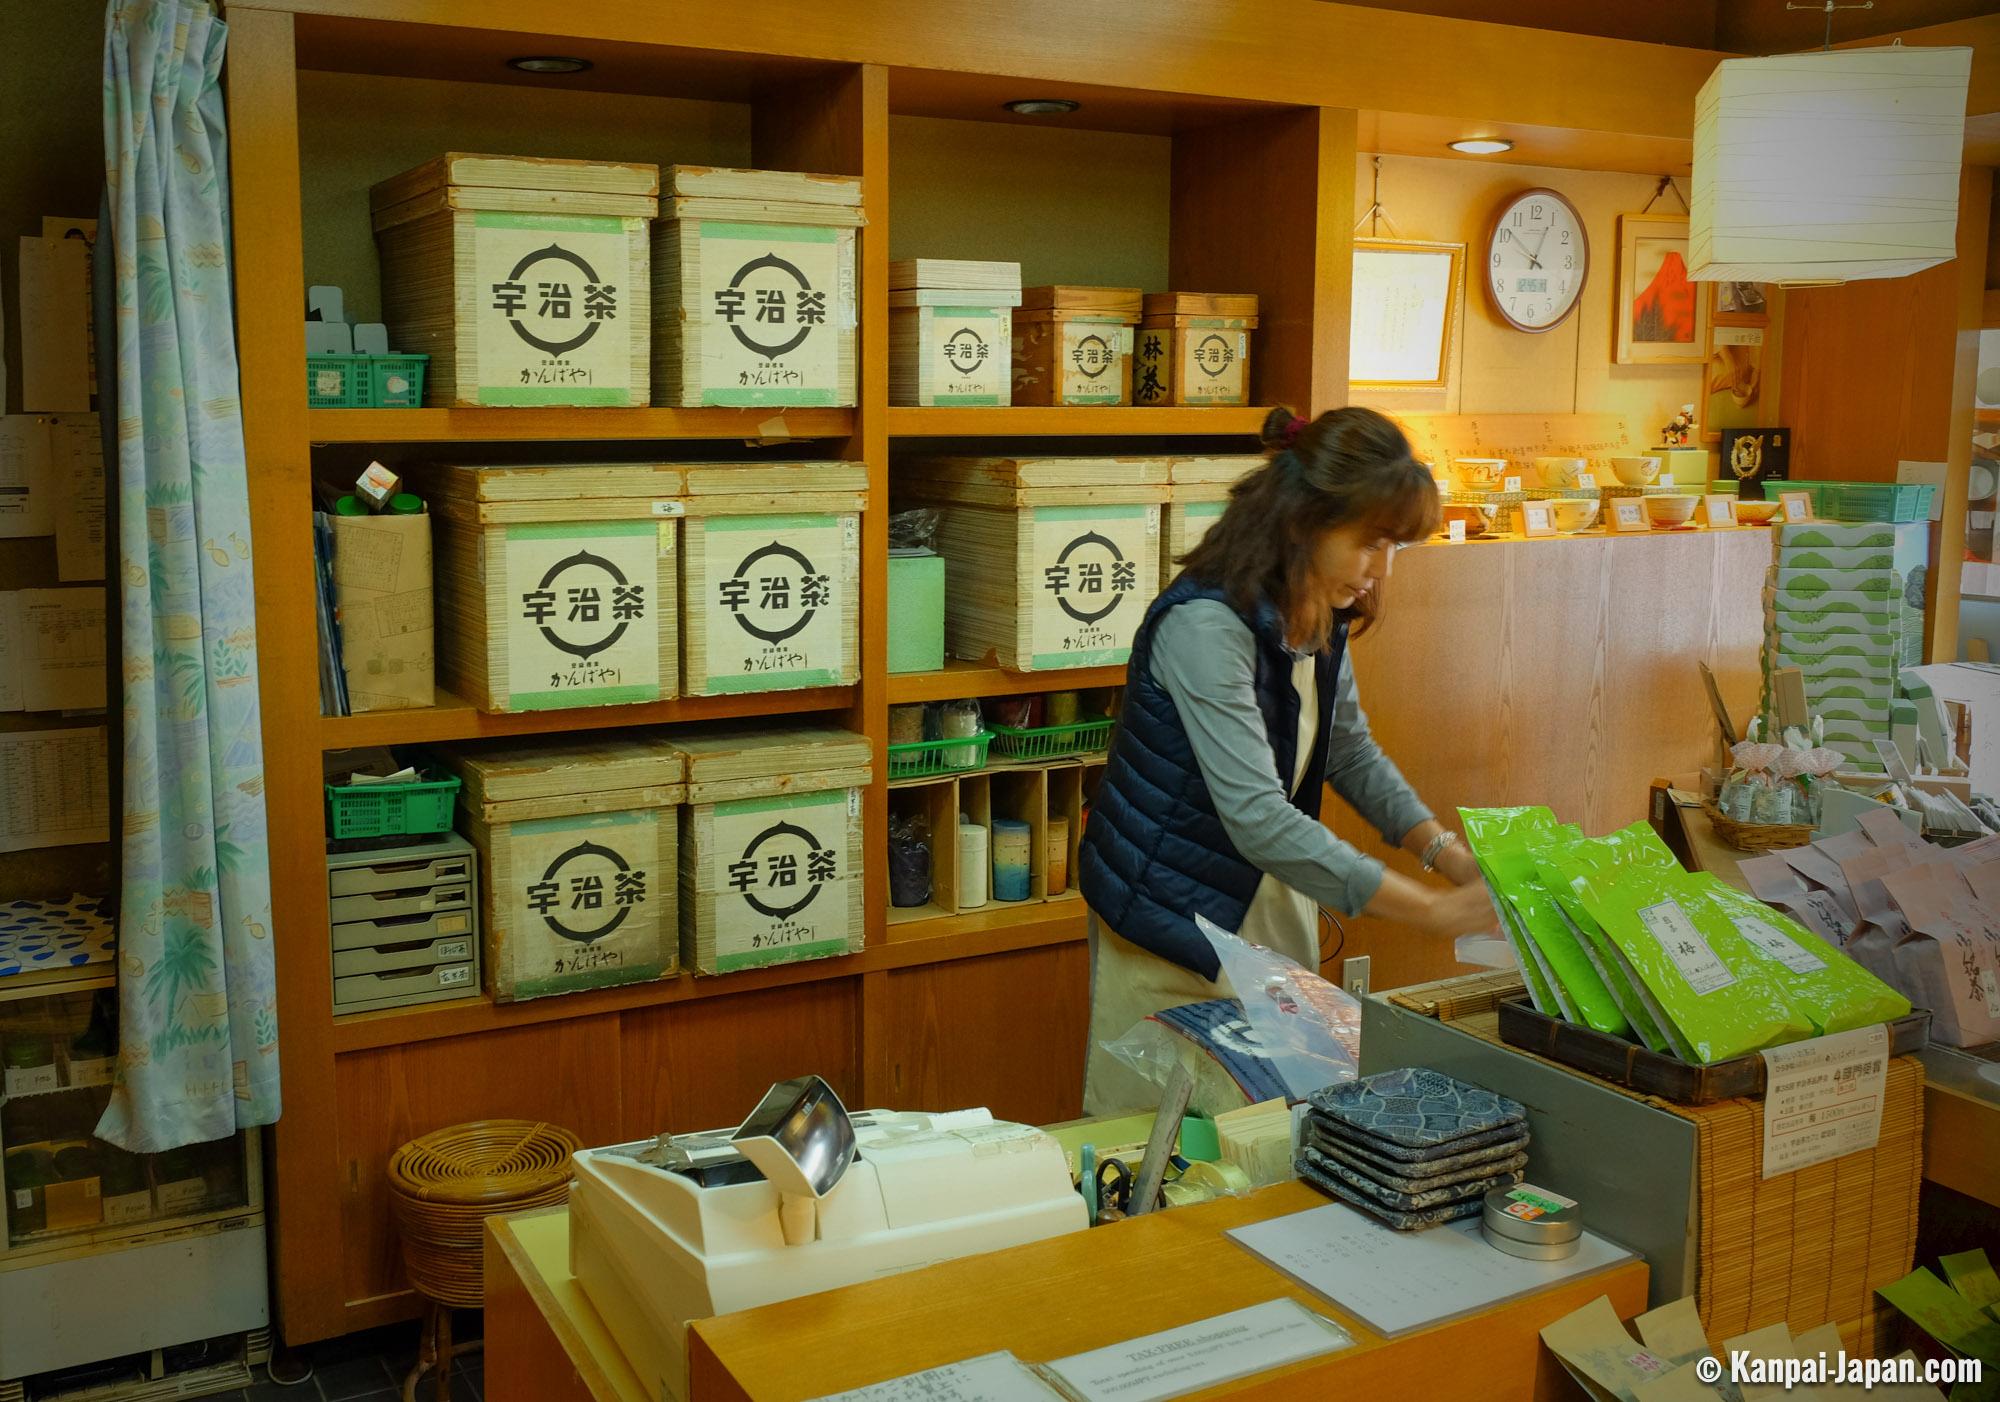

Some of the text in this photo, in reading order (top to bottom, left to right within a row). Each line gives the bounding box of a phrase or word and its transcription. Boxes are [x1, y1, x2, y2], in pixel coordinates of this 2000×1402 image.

[1513, 212, 1522, 227] 11
[1530, 205, 1542, 220] 12
[1550, 211, 1556, 227] 1
[1561, 230, 1569, 245] 2
[1493, 253, 1501, 268] 9
[1564, 255, 1572, 270] 3
[1497, 279, 1504, 293] 8
[1559, 279, 1566, 295] 4
[492, 282, 616, 320] 宇治茶
[715, 289, 826, 324] 宇治茶
[1510, 296, 1517, 312] 7
[1545, 297, 1552, 312] 5
[1527, 304, 1534, 319] 6
[943, 343, 989, 359] 宇治茶
[1072, 348, 1113, 364] 宇治茶
[1194, 348, 1234, 363] 宇治茶
[1044, 562, 1136, 595] 宇治茶
[719, 574, 830, 612] 宇治茶
[523, 585, 645, 625] 宇治茶
[728, 850, 836, 892] 宇治茶
[527, 871, 646, 914] 宇治茶
